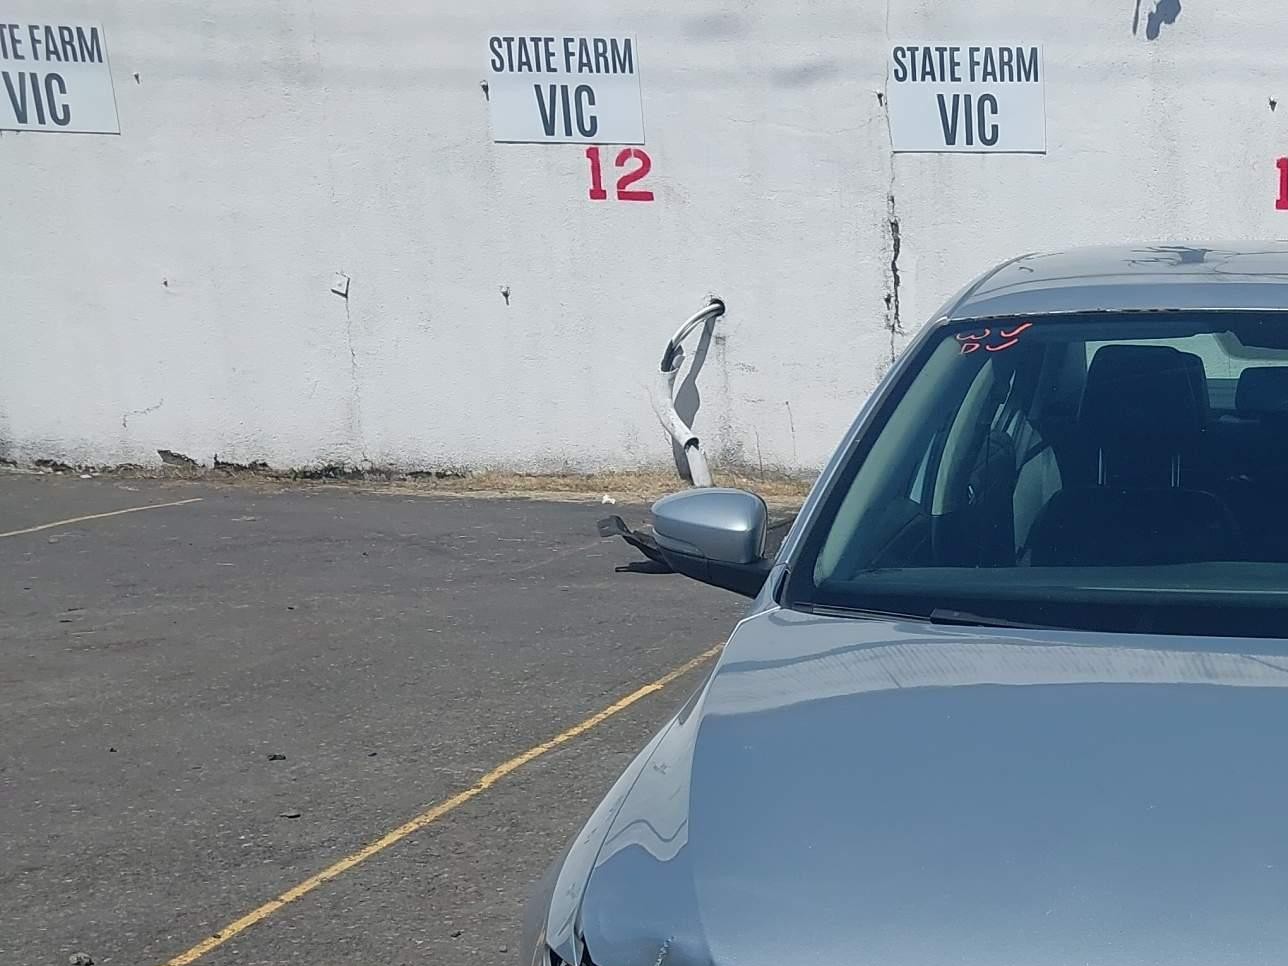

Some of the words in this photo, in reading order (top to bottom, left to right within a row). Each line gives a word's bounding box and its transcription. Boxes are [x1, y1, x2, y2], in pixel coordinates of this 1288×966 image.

[28, 24, 103, 63] FARM
[490, 37, 558, 73] STATE
[563, 38, 634, 75] FARM
[893, 46, 961, 83] STATE
[968, 46, 1039, 83] FARM
[2, 71, 70, 126] VIC
[534, 84, 598, 137] VIC
[937, 93, 999, 146] VIC
[586, 147, 654, 201] 12
